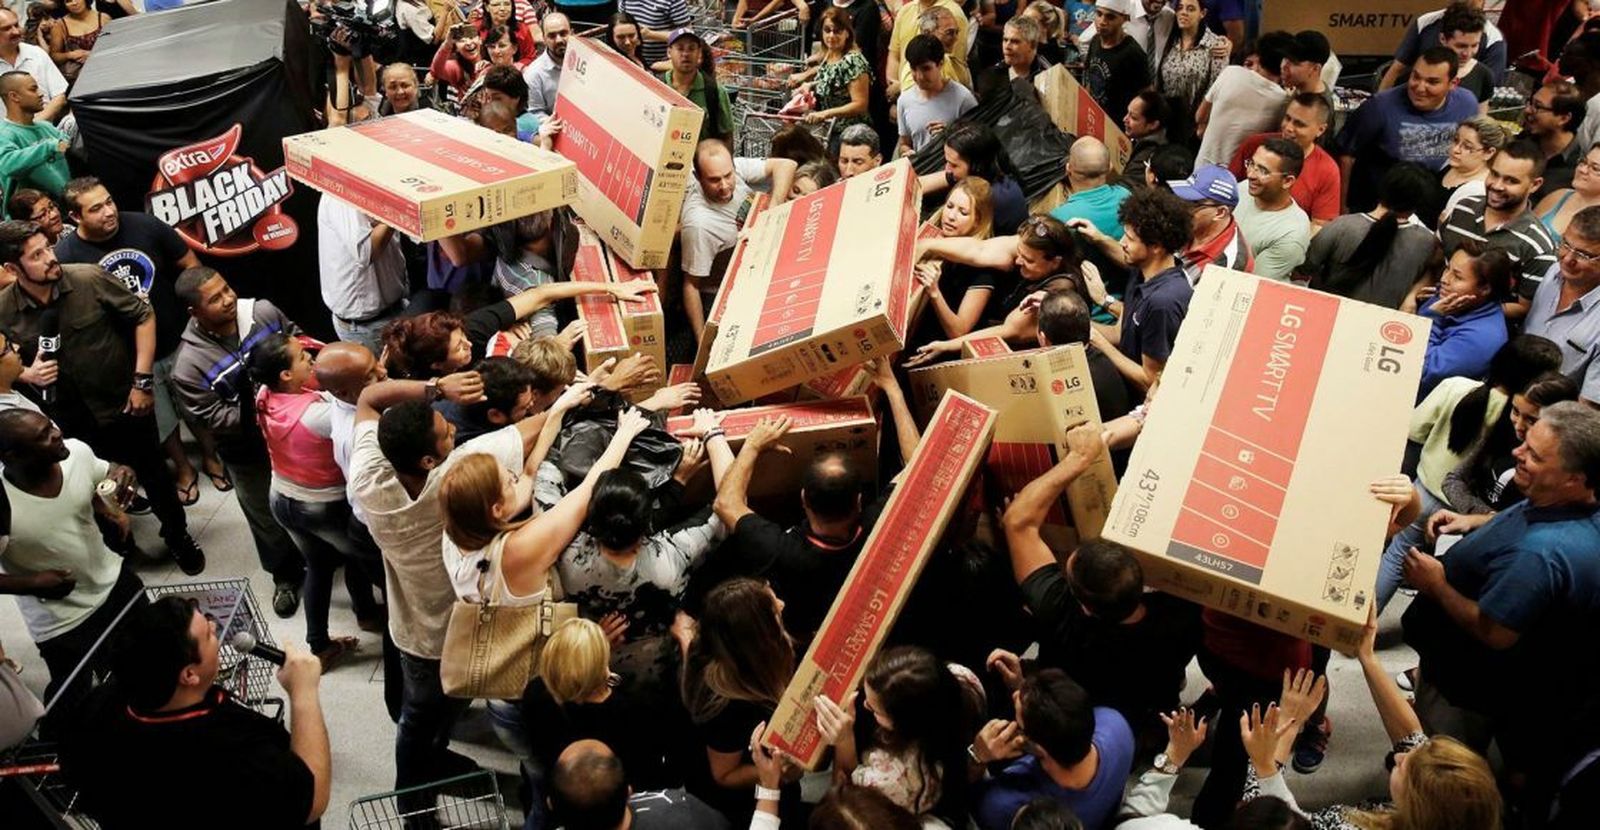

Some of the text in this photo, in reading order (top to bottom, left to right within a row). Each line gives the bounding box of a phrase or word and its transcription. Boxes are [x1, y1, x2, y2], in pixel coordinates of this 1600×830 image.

[1328, 12, 1413, 28] SMART TV
[576, 57, 587, 76] LG
[681, 131, 692, 140] LG
[164, 150, 211, 177] extra
[400, 176, 422, 188] LG
[874, 180, 892, 198] LG
[151, 162, 255, 228] BLACK
[202, 170, 289, 245] FRIDAY
[445, 203, 454, 217] LG
[809, 196, 825, 213] LG
[643, 335, 656, 343] LG
[860, 339, 873, 351] LG
[1252, 303, 1305, 422] LG SMART TV
[1377, 345, 1404, 375] LG
[1064, 376, 1081, 390] LG
[1194, 553, 1234, 572] 43LH57
[831, 588, 888, 685] LG SMART TV
